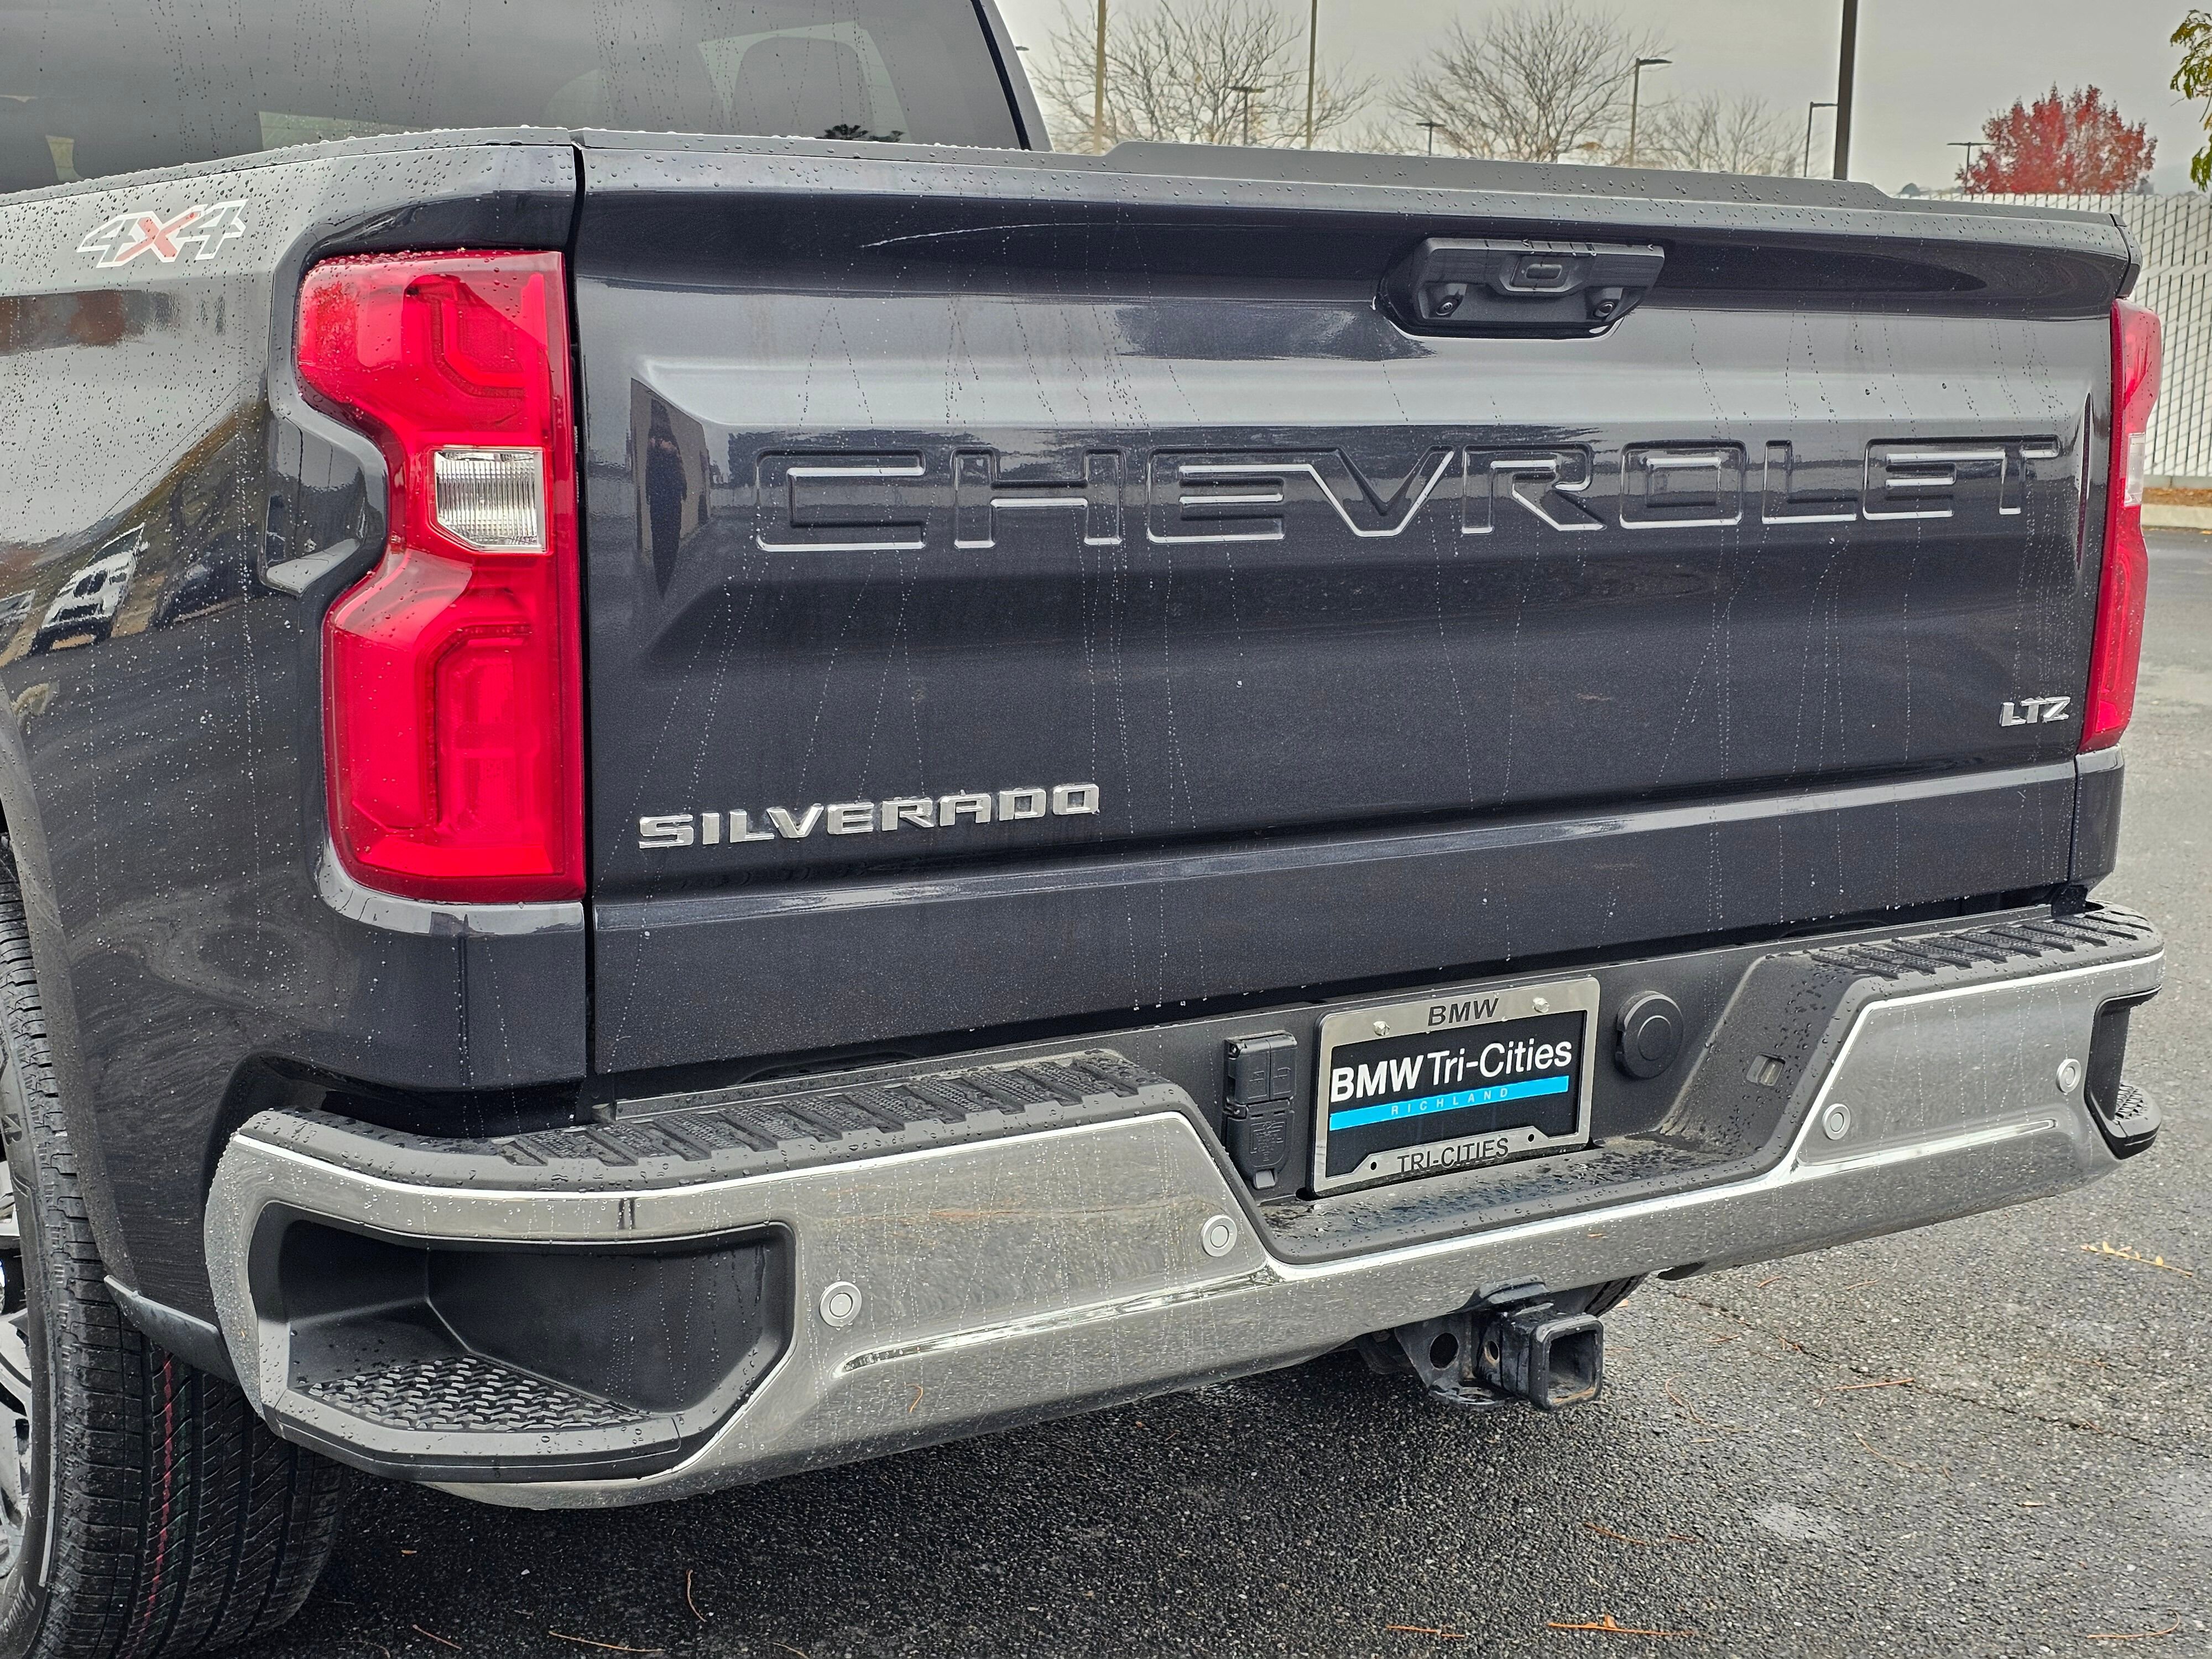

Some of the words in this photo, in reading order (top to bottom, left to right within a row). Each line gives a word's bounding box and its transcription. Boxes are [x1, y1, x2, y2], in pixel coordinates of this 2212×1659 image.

[755, 434, 2061, 552] CHEVROLET
[2000, 696, 2071, 727] LTZ
[639, 783, 1100, 849] SILVERADO
[1428, 998, 1499, 1027] BMW
[1330, 1055, 1424, 1103] BMW
[1427, 1037, 1573, 1086] Tri-Cities
[1391, 1087, 1509, 1115] RICHLAND
[1397, 1137, 1509, 1172] TRI-CITIES
